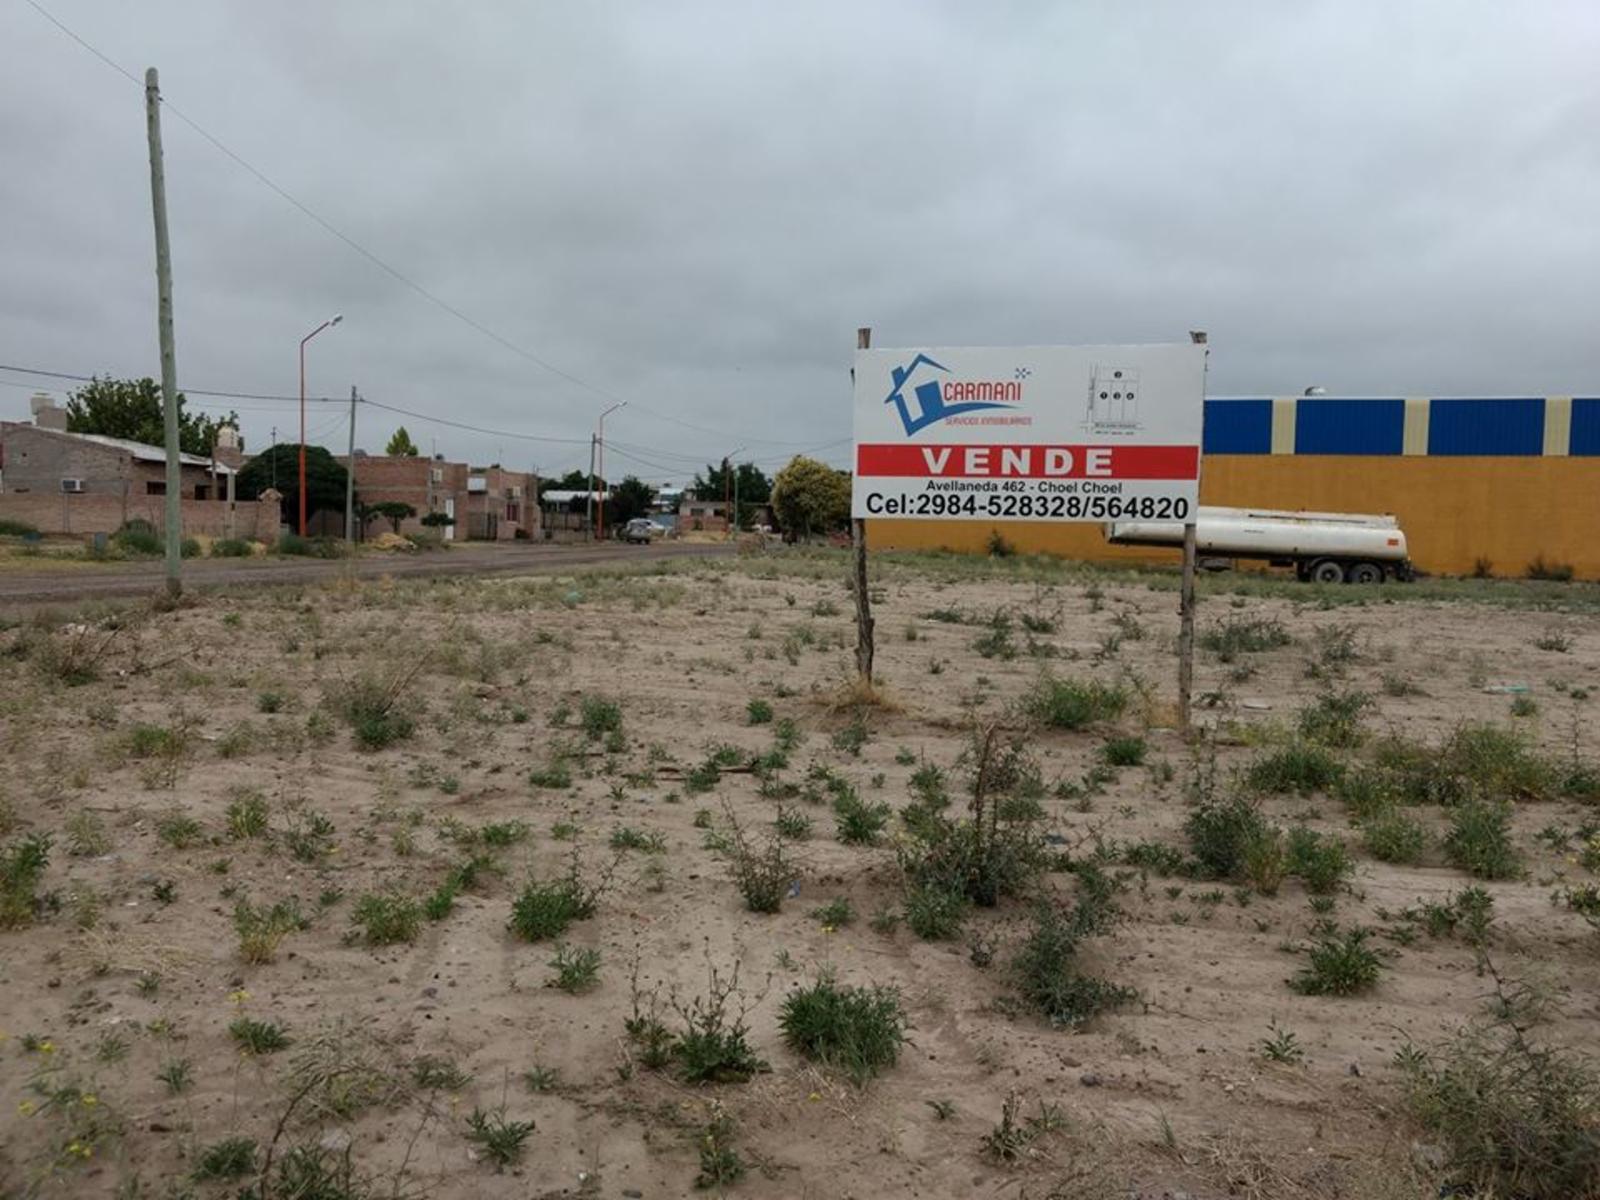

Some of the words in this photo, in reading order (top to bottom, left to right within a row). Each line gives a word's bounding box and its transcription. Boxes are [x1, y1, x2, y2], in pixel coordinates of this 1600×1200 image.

[943, 382, 1021, 401] CARMANI
[921, 447, 1113, 476] VENDE
[926, 479, 998, 492] Avellaneda
[1002, 480, 1026, 493] 462
[1038, 481, 1078, 493] Choel
[1082, 482, 1123, 494] Choel
[866, 493, 1189, 519] Cel:2984-528328/564820
